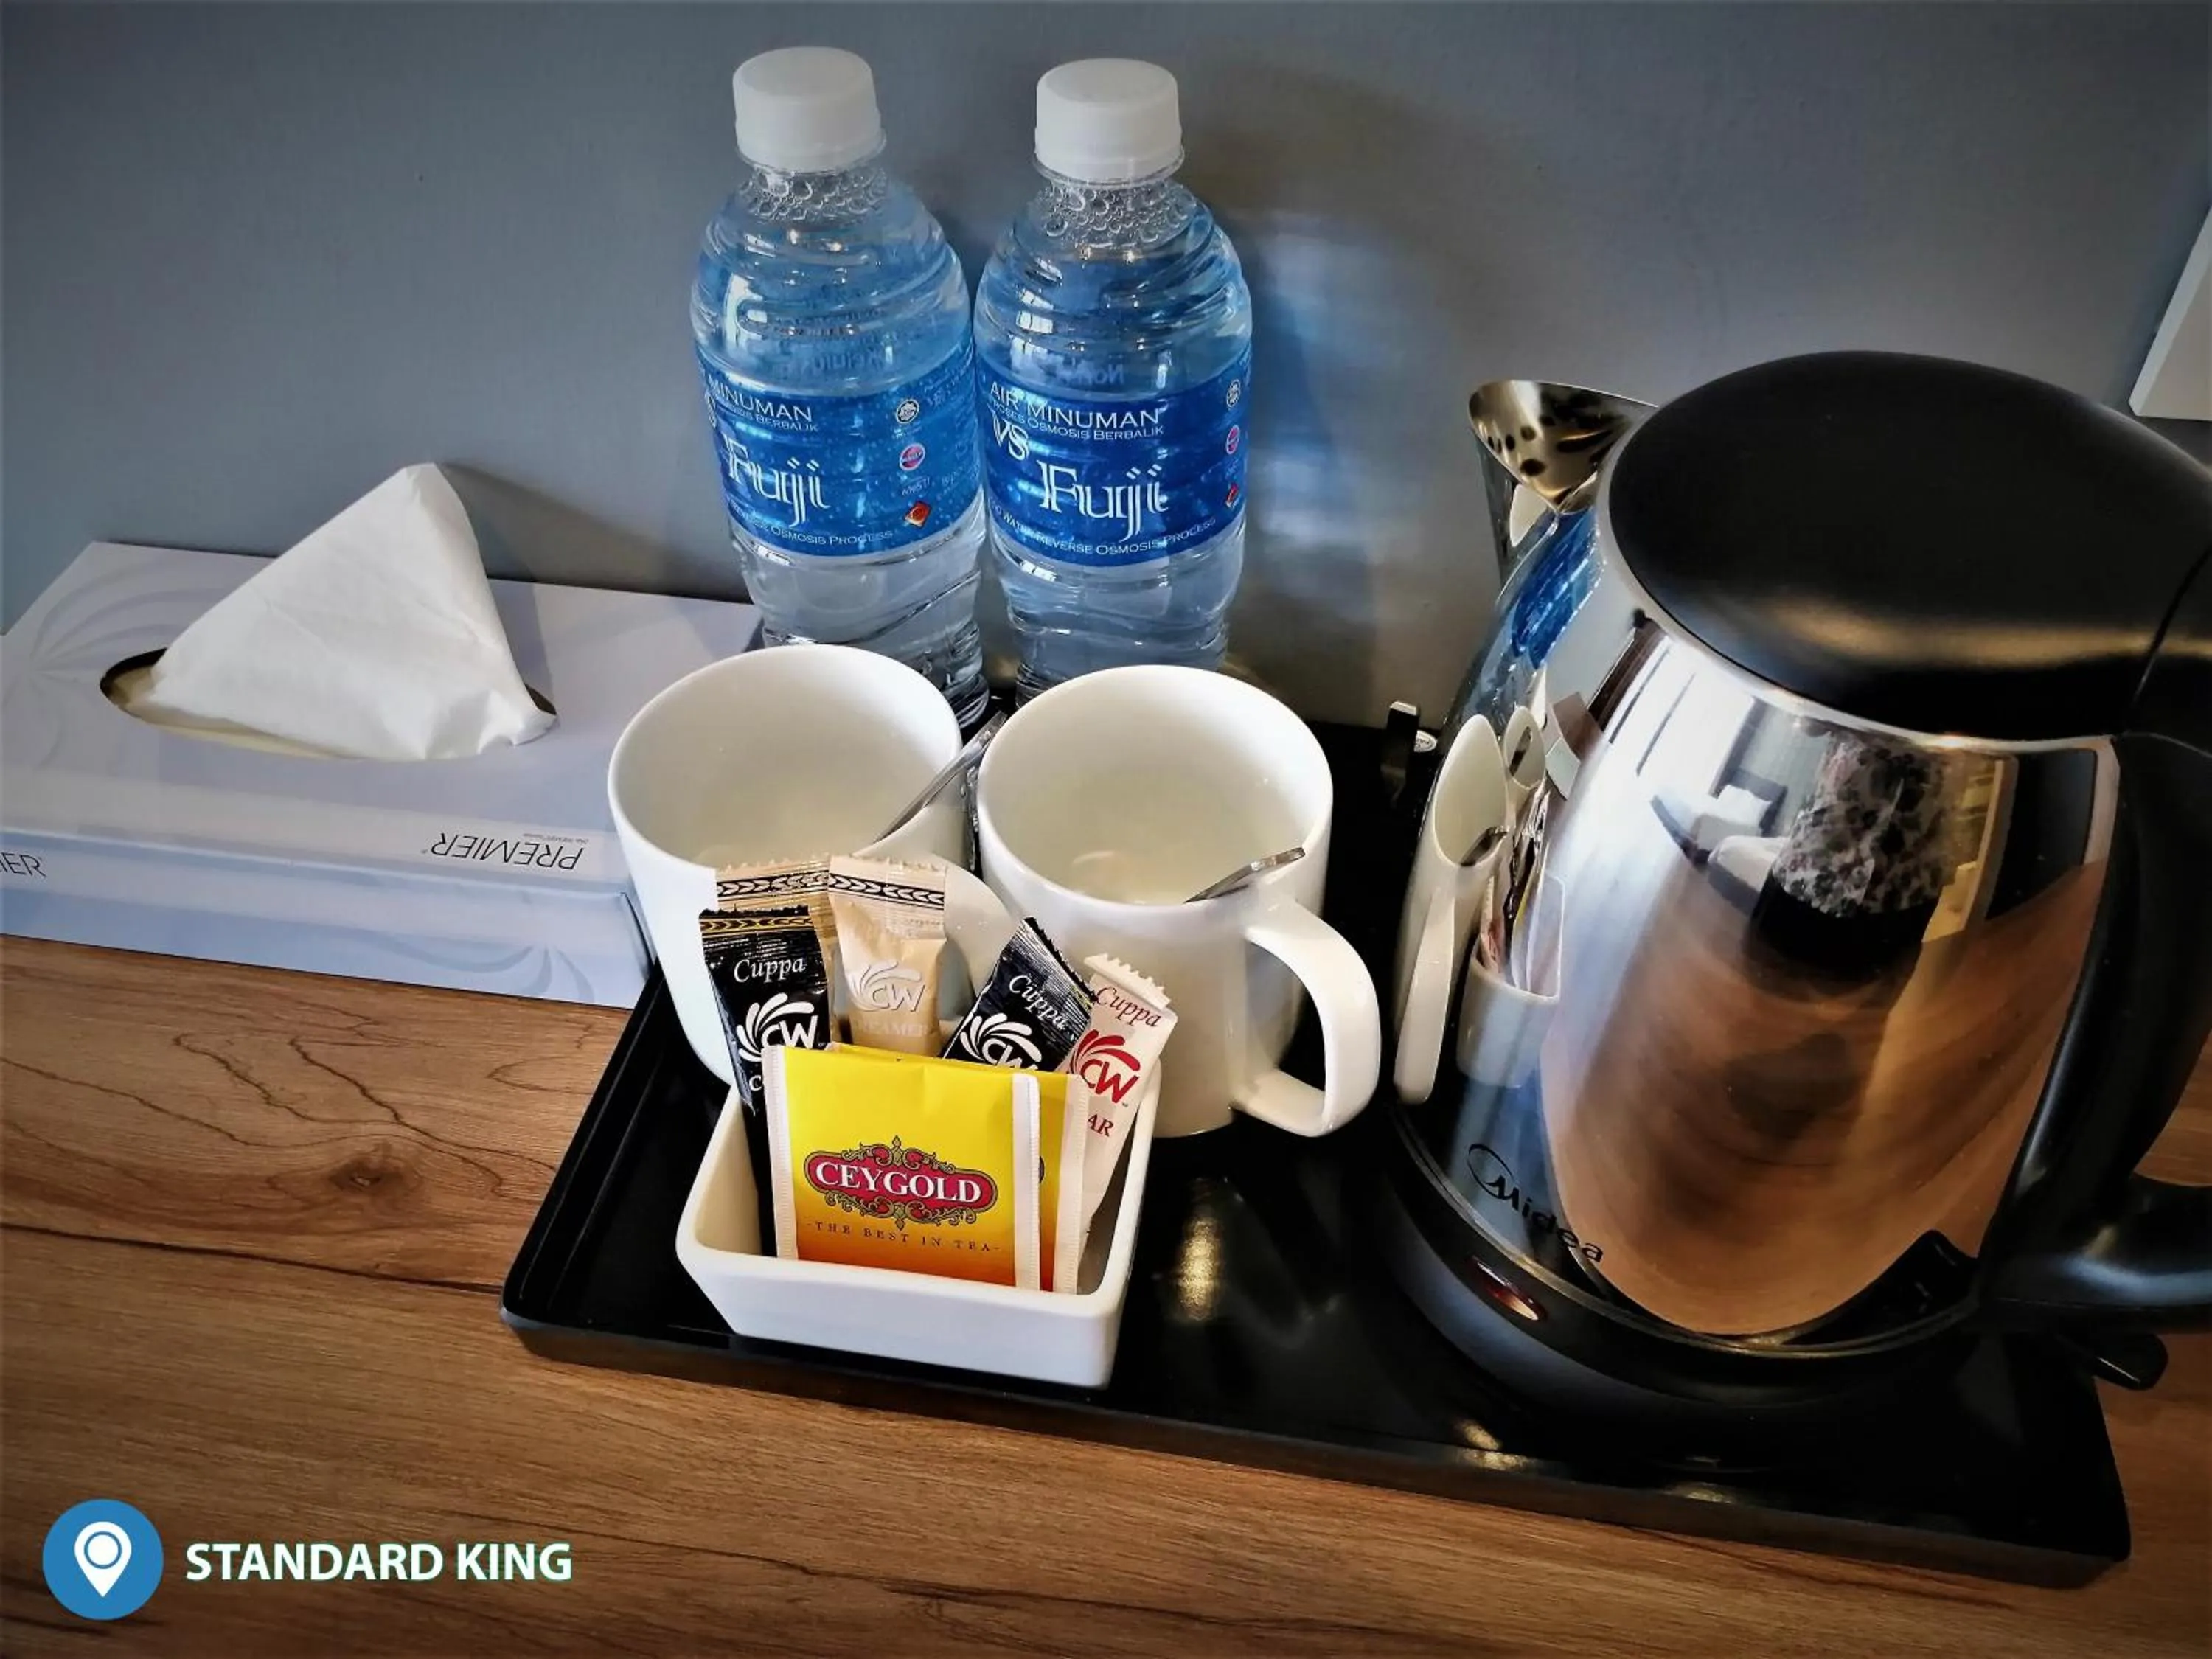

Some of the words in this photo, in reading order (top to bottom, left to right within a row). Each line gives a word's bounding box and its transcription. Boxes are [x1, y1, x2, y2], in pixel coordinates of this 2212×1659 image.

[990, 381, 1018, 410] AIR
[1027, 401, 1160, 429] MINUMAN
[987, 403, 1030, 461] VS
[1027, 417, 1091, 439] OSMOSIS
[1094, 425, 1165, 441] BERBALIK
[1037, 460, 1169, 542] Fuji
[1096, 540, 1159, 555] OSMOSIS
[431, 832, 585, 870] PREMIER
[734, 956, 806, 983] Cuppa
[1009, 975, 1068, 1031] Cuppa
[1096, 986, 1163, 1028] Cuppa
[815, 1161, 982, 1204] CEYGOLD
[864, 1228, 909, 1243] BEST
[922, 1235, 942, 1248] IN
